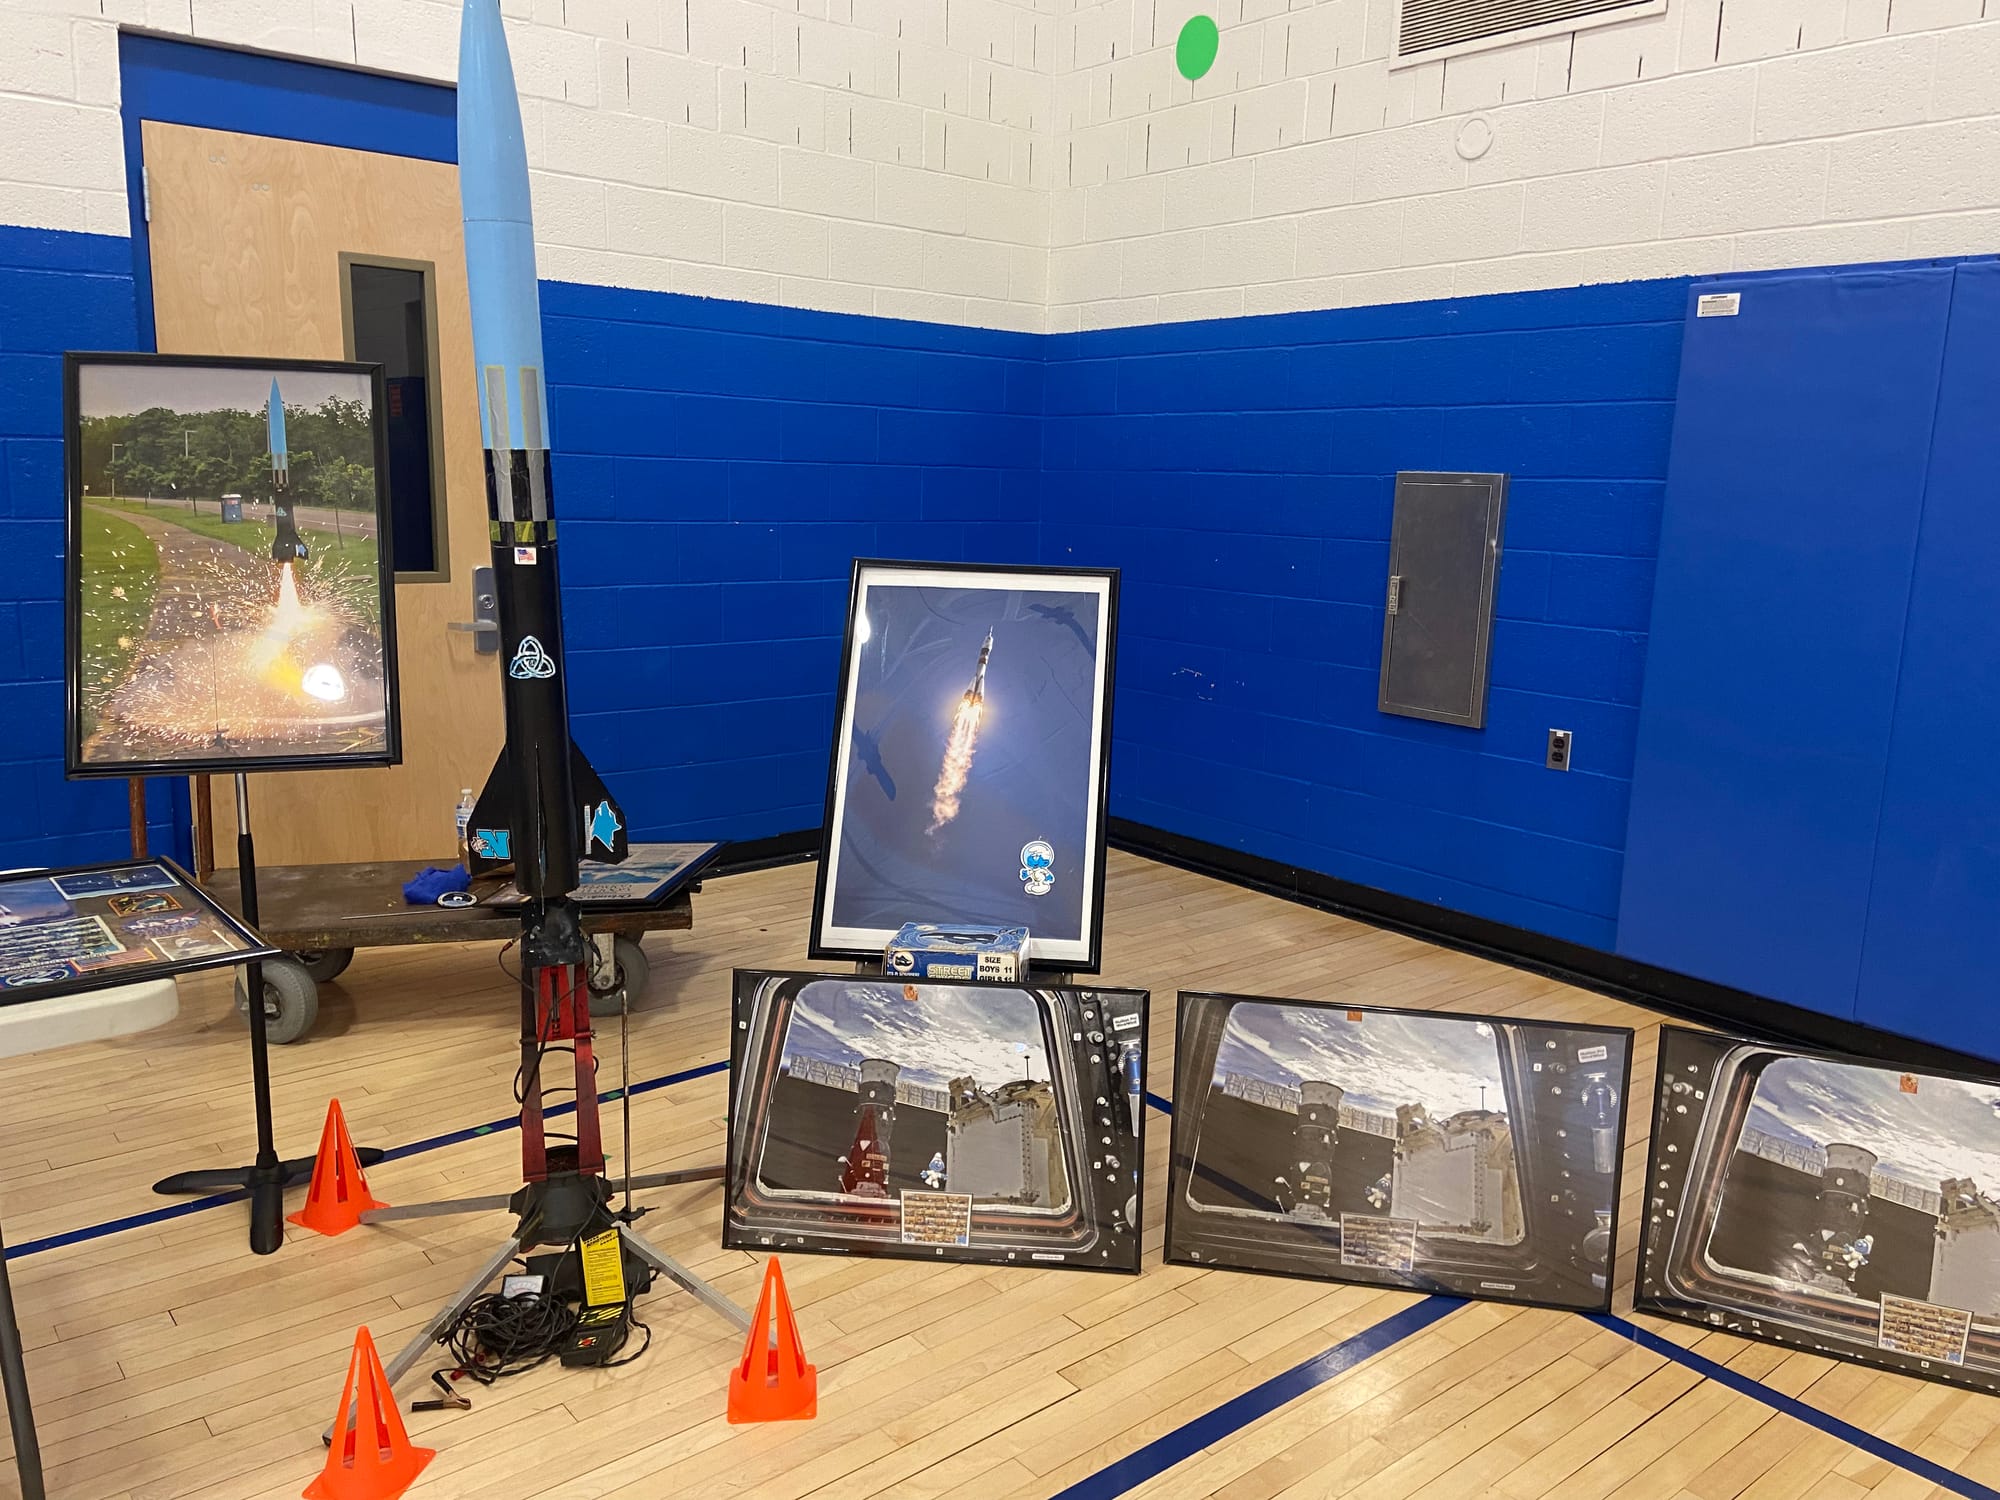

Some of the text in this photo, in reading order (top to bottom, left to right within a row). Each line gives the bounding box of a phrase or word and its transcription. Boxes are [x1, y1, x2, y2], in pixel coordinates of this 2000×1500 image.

[985, 956, 1001, 964] SIZE
[928, 965, 972, 977] STREET
[979, 965, 1013, 974] BOYS 11
